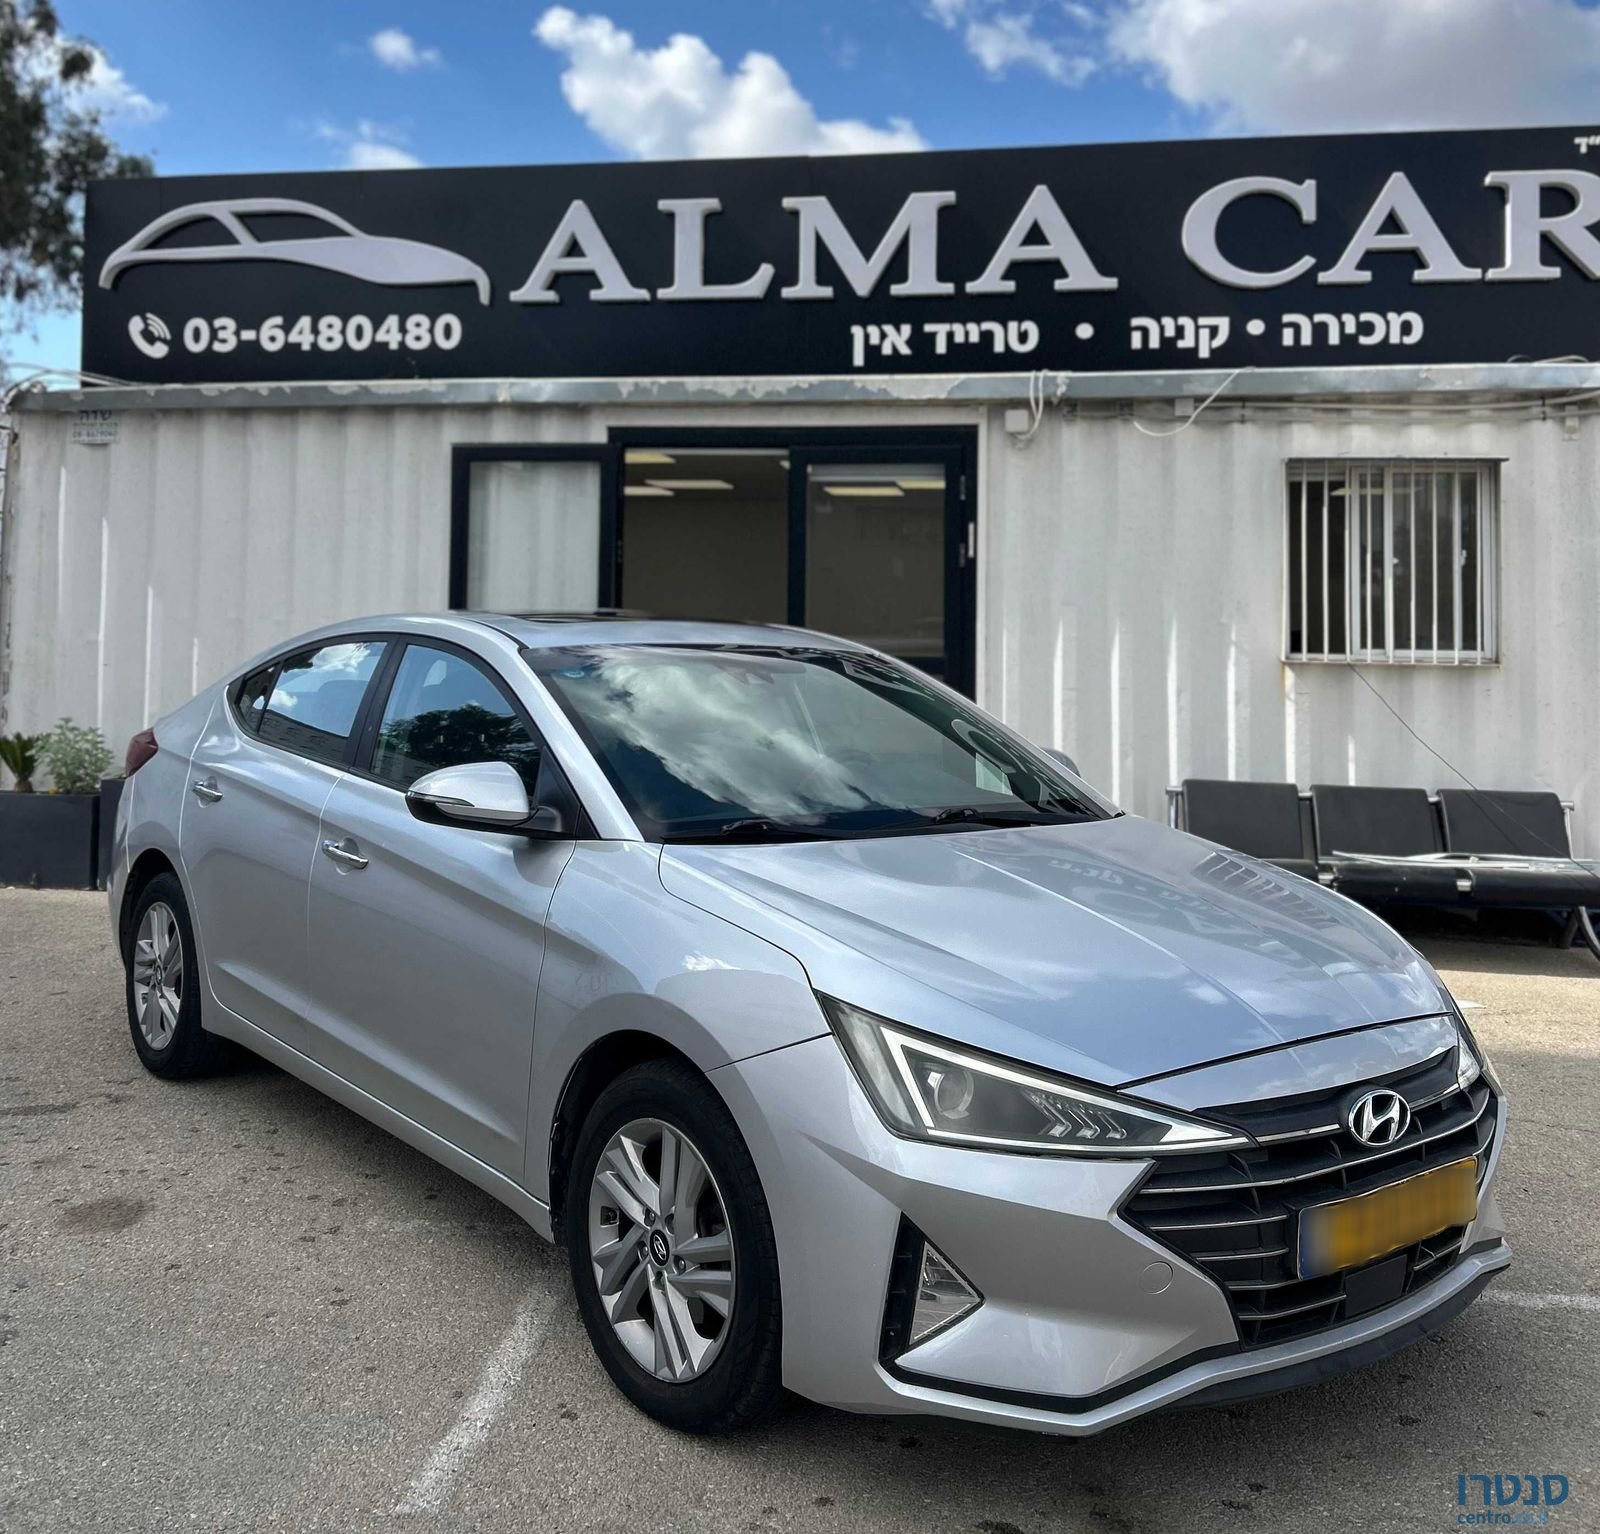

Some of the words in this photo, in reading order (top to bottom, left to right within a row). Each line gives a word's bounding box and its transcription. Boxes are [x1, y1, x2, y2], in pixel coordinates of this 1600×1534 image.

[509, 184, 1118, 304] ALMA
[1181, 169, 1600, 288] CAR
[183, 313, 463, 354] 03-6480480
[849, 322, 912, 368] אין
[922, 319, 1040, 355] טרייד
[1130, 315, 1230, 360] קניה
[1281, 311, 1424, 347] מכירה
